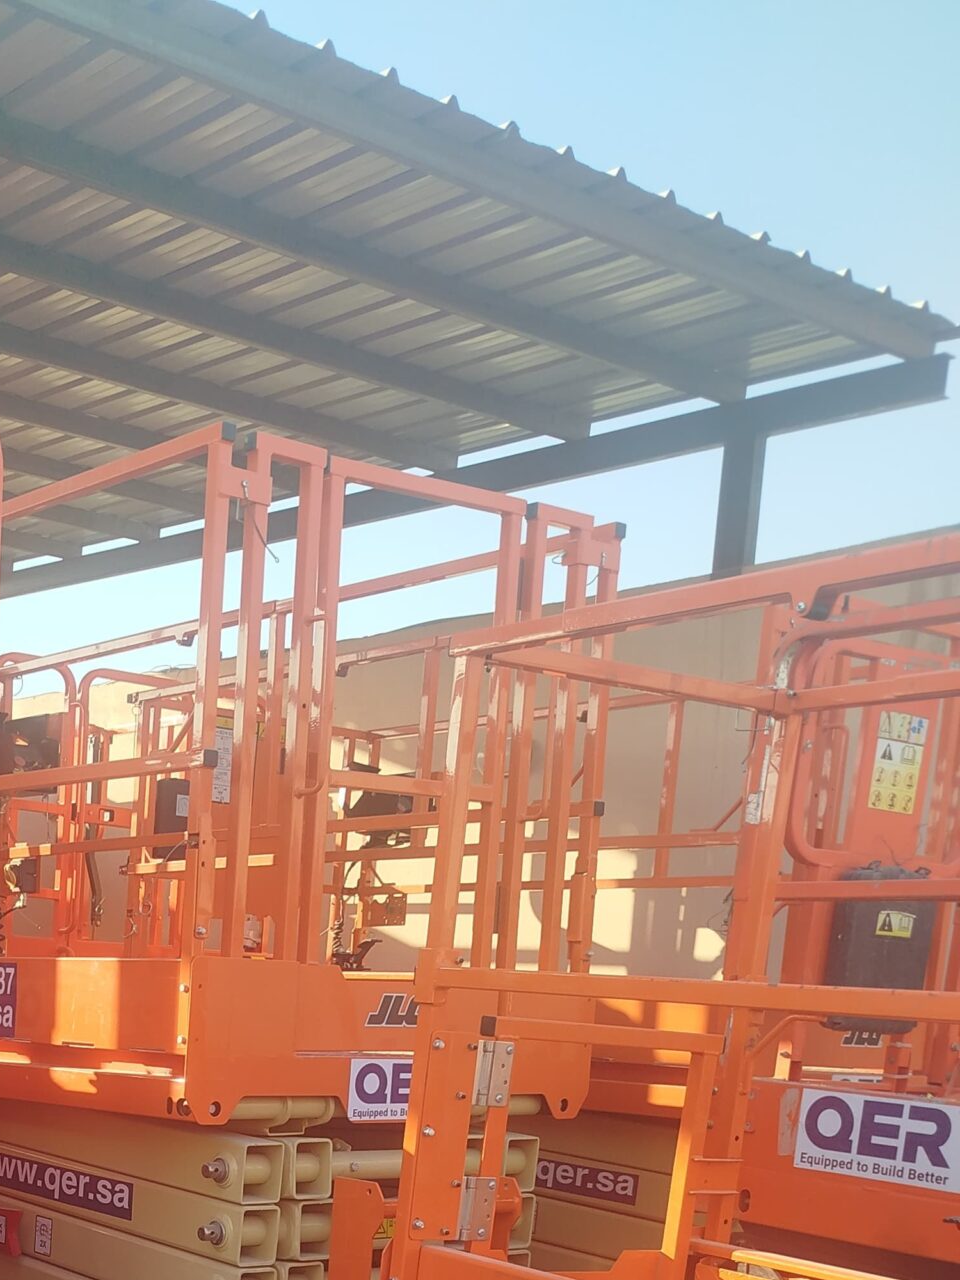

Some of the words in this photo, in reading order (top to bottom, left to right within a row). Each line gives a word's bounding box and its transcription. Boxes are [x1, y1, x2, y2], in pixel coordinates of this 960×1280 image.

[352, 1108, 388, 1119] Equipped
[390, 1108, 398, 1117] to
[805, 1095, 952, 1169] QER
[800, 1152, 853, 1170] Equipped
[856, 1160, 868, 1172] to
[872, 1163, 904, 1178] Build
[908, 1169, 949, 1185] Better
